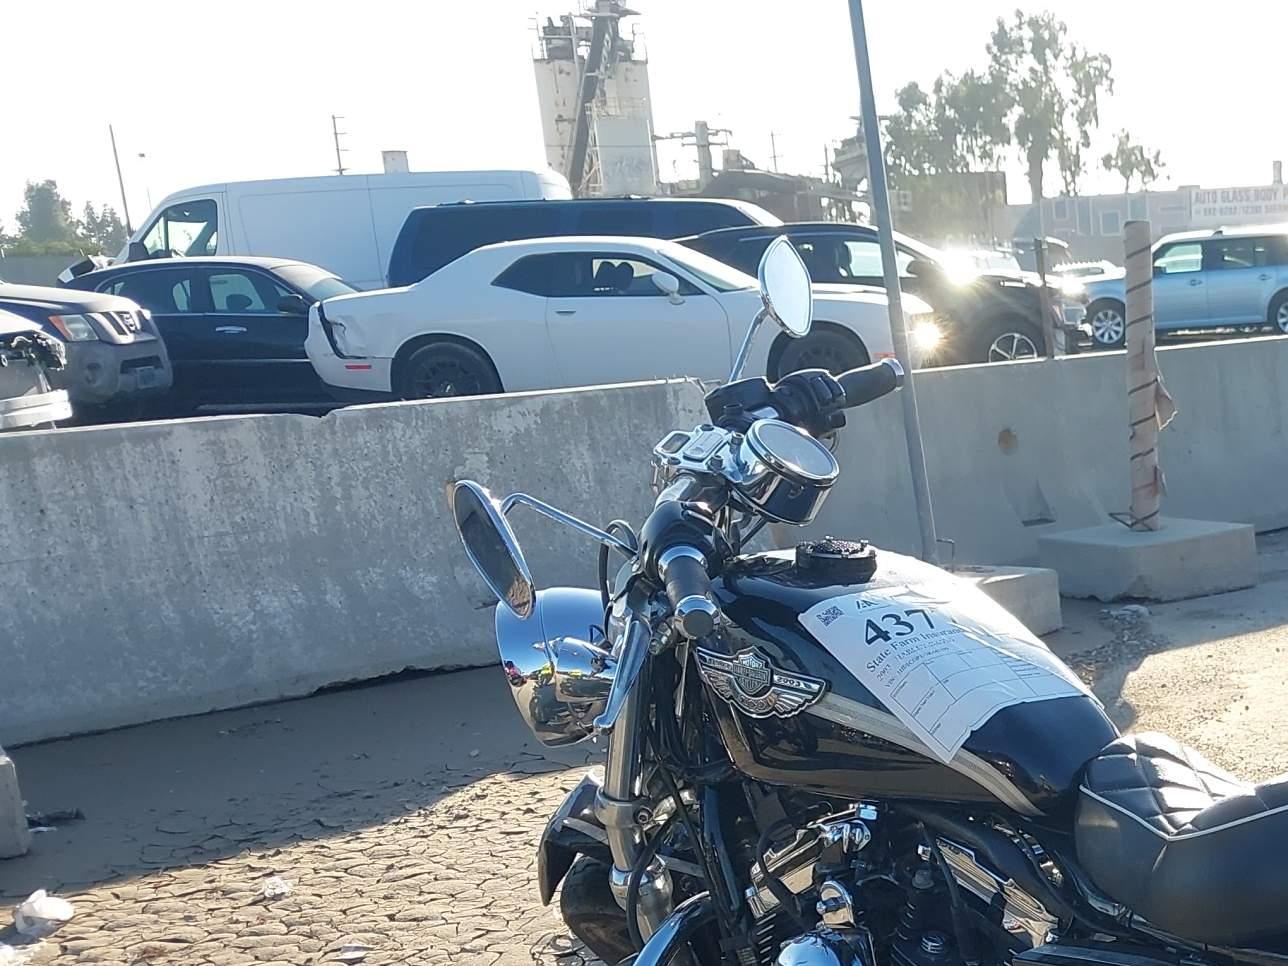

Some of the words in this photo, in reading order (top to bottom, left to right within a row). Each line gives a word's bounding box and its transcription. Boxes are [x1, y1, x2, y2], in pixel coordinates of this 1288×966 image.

[1195, 191, 1217, 204] AUTO
[865, 609, 934, 645] 437
[867, 648, 891, 673] State
[890, 636, 921, 650] Farm
